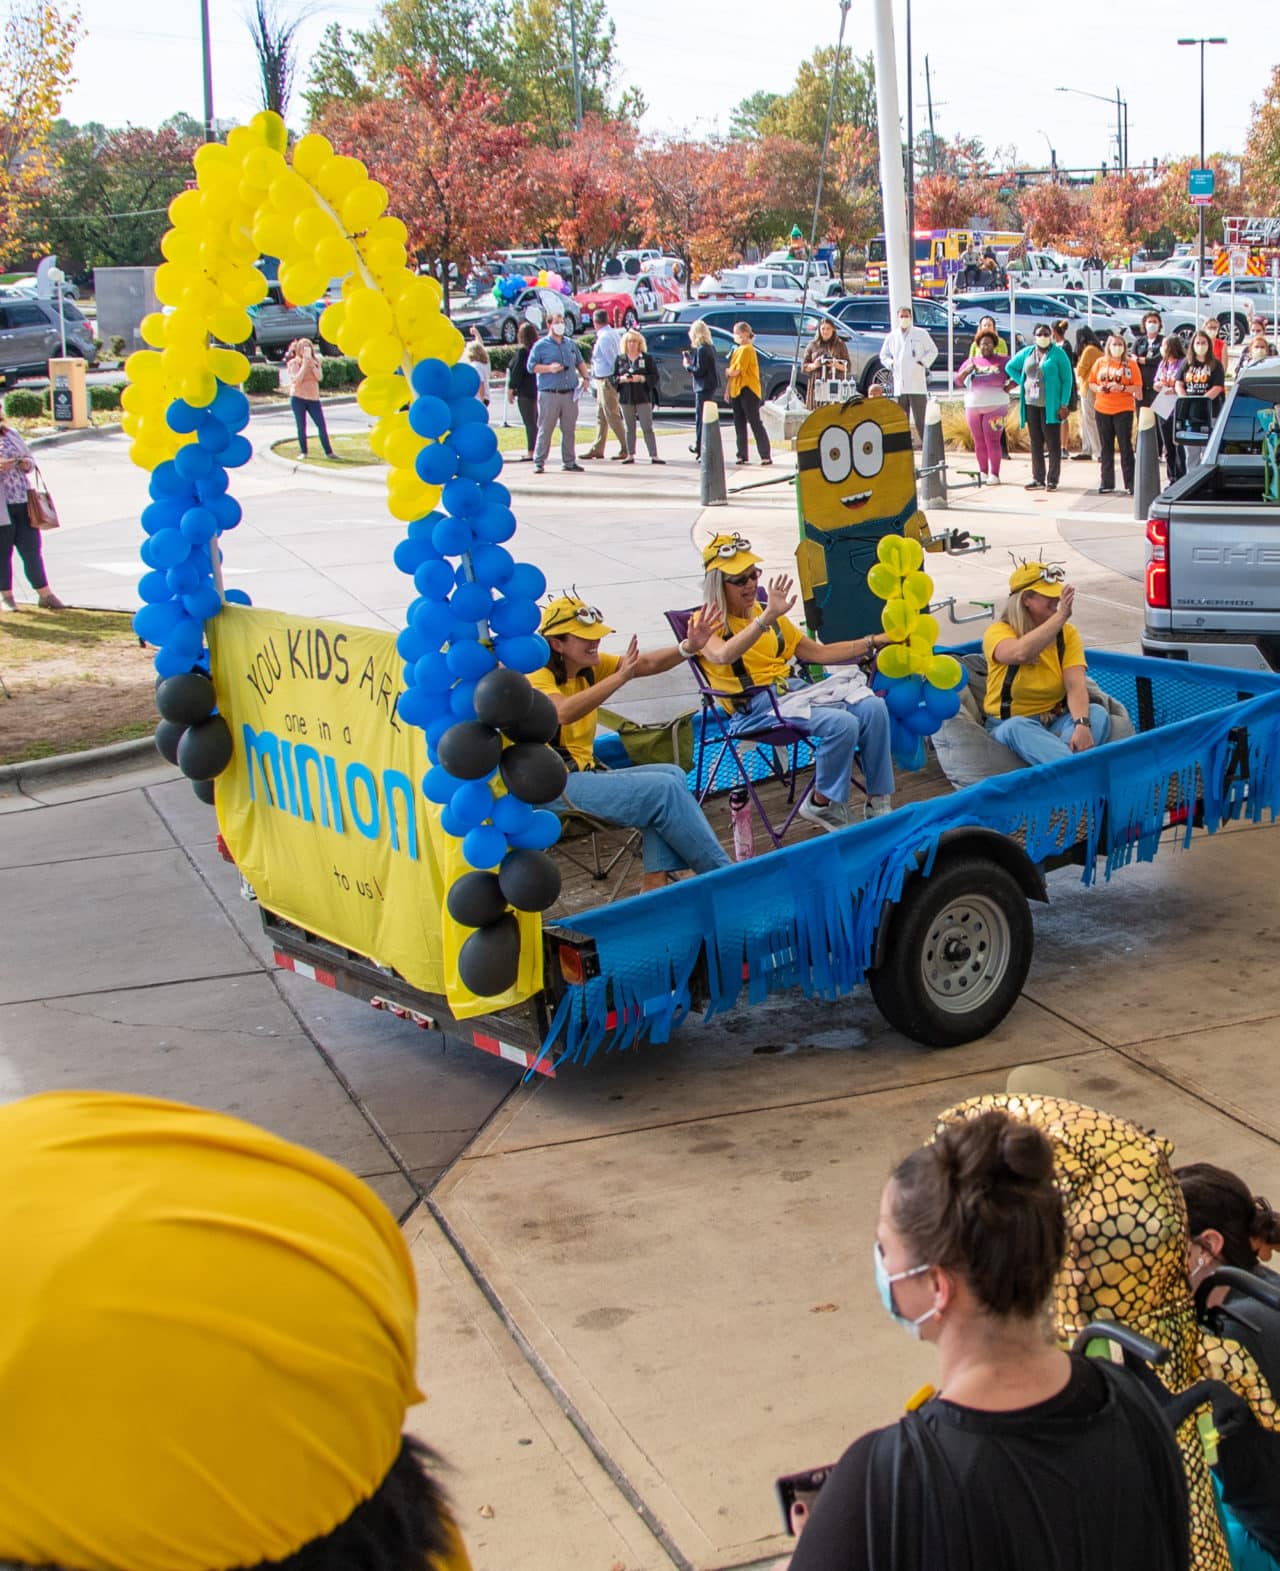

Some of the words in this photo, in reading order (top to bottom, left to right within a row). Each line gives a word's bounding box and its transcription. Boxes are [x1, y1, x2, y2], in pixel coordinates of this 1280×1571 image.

[1177, 599, 1254, 607] SILVERADO
[247, 636, 281, 704] YOU
[288, 629, 349, 684] KIDS
[285, 714, 307, 735] one
[317, 718, 332, 741] in
[343, 726, 352, 744] a
[334, 865, 350, 891] to
[356, 876, 385, 901] us!
